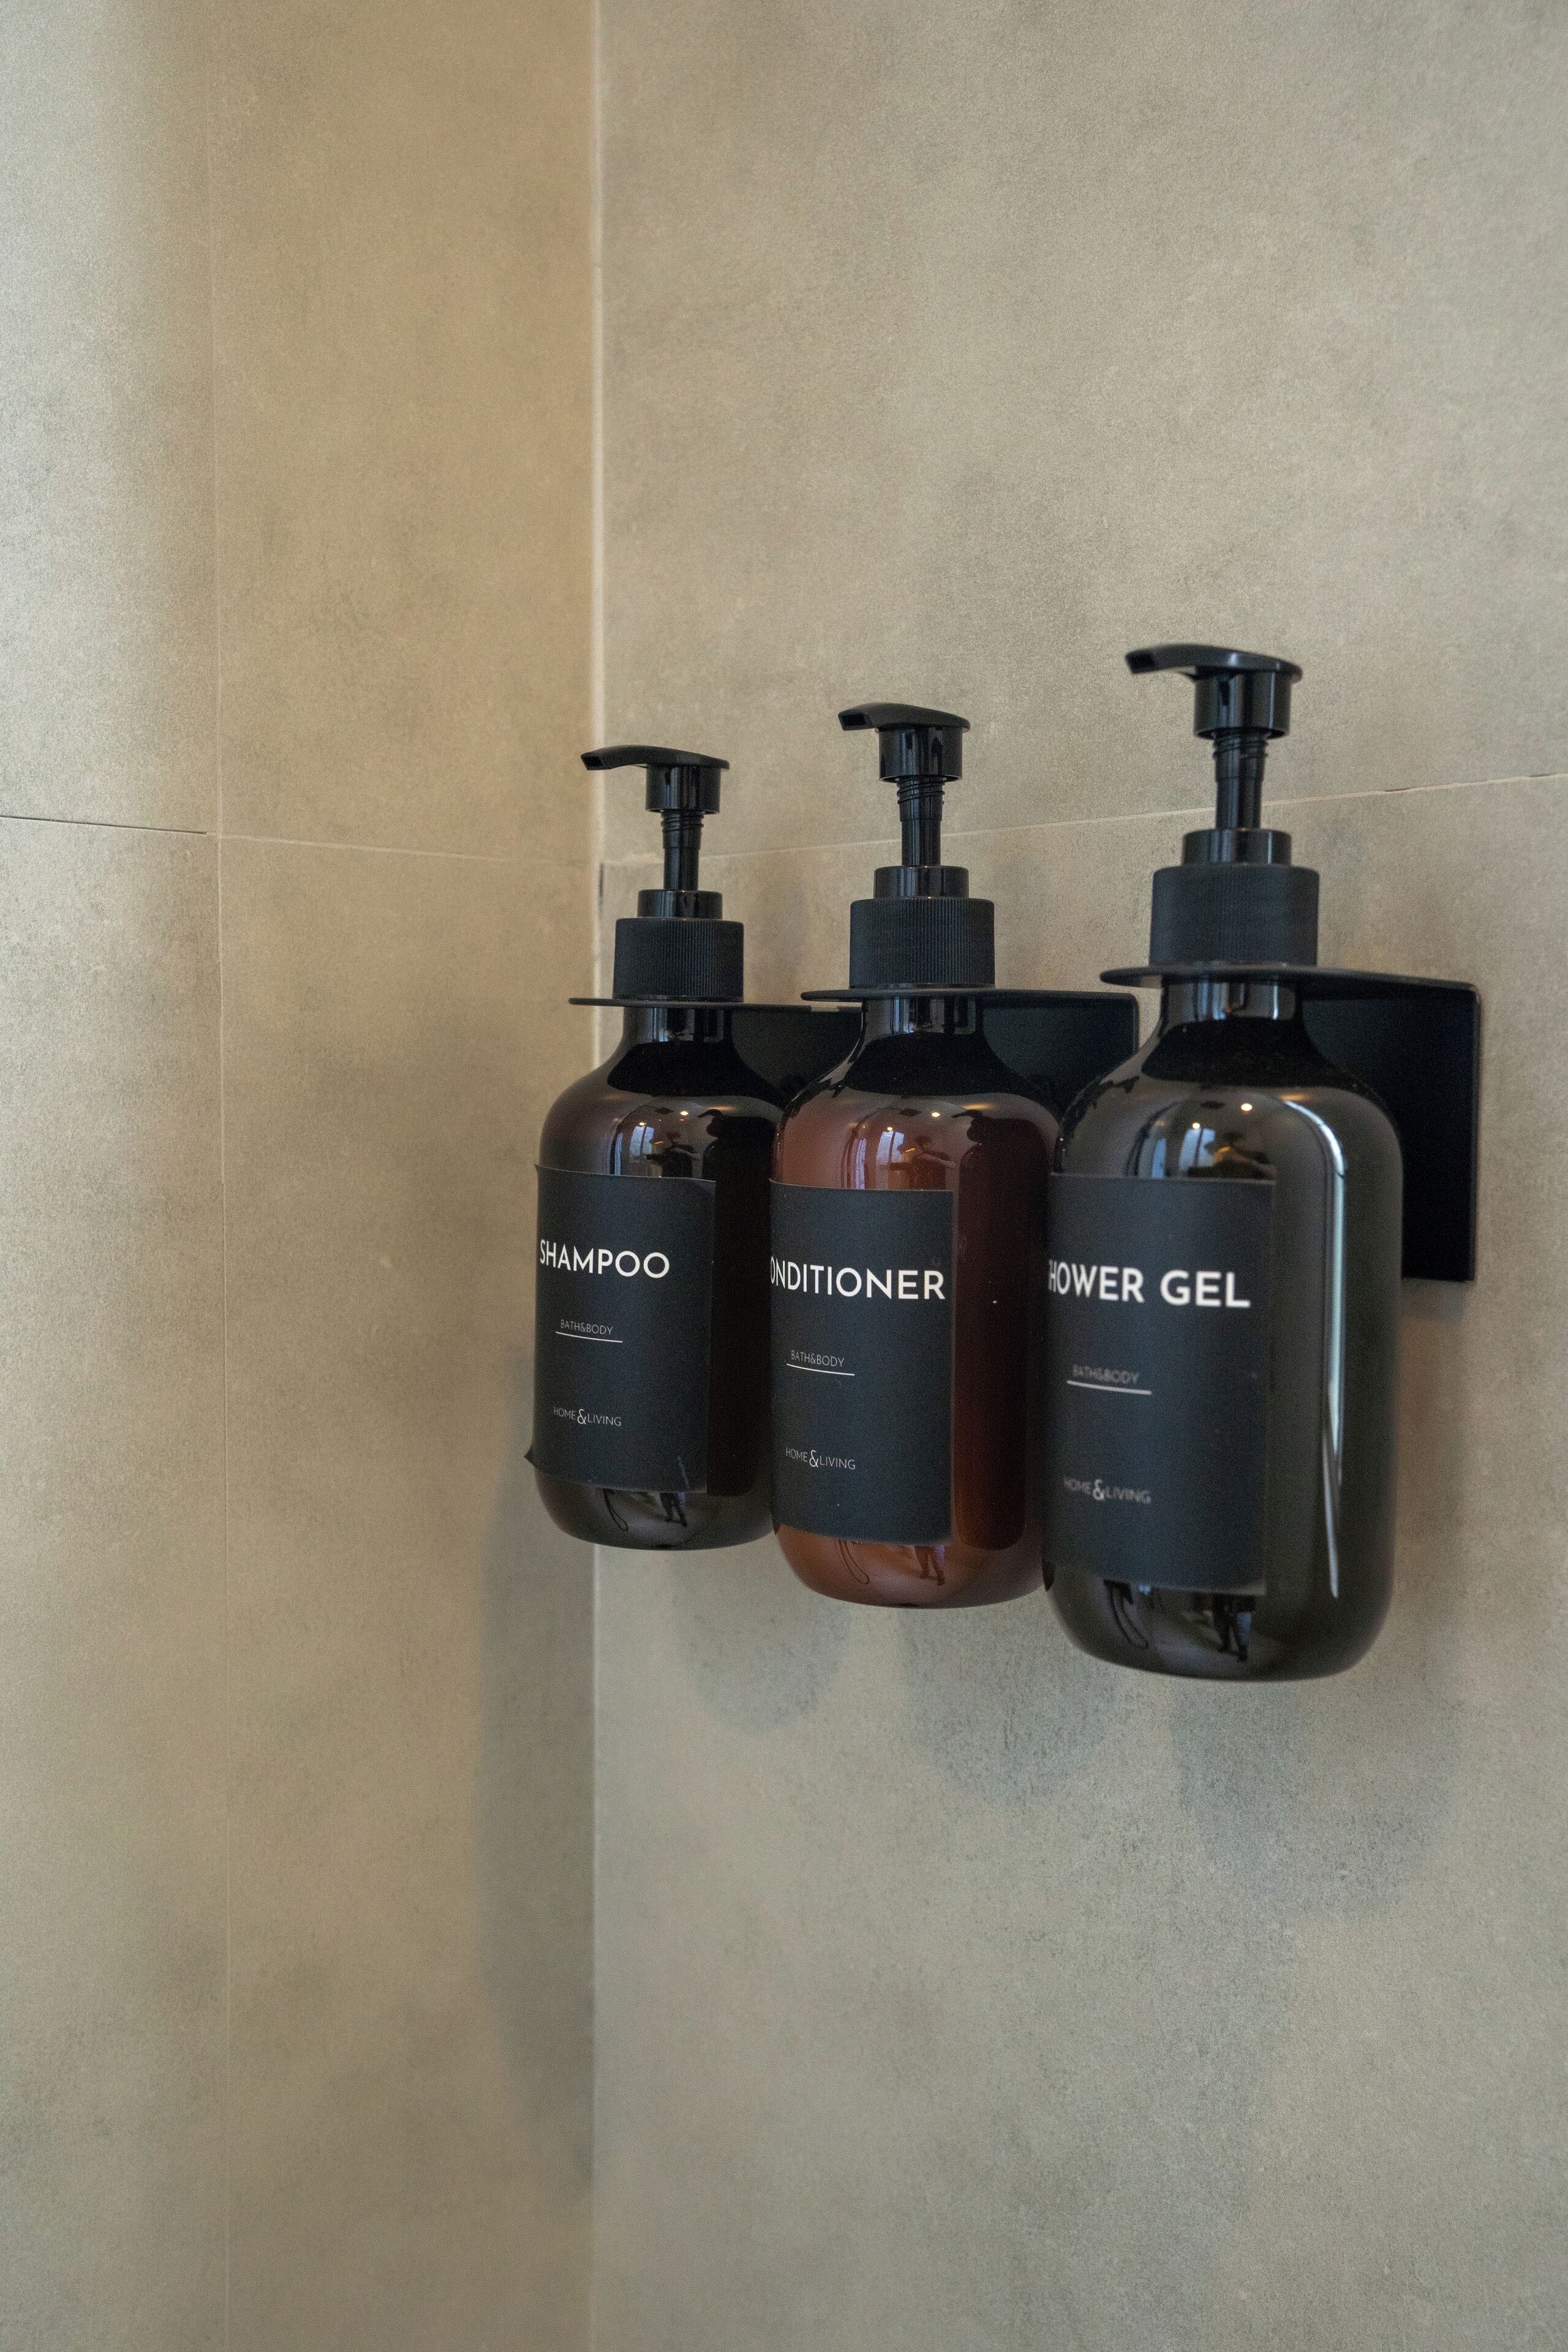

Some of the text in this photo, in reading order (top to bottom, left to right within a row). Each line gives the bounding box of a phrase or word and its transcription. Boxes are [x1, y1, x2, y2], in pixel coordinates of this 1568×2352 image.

[540, 1239, 669, 1278] SHAMPOO
[771, 1256, 945, 1300] ONDITIONER
[1048, 1259, 1251, 1308] HOWER GEL
[560, 1319, 613, 1335] BATH&BODY
[791, 1350, 845, 1367] BATH&BODY
